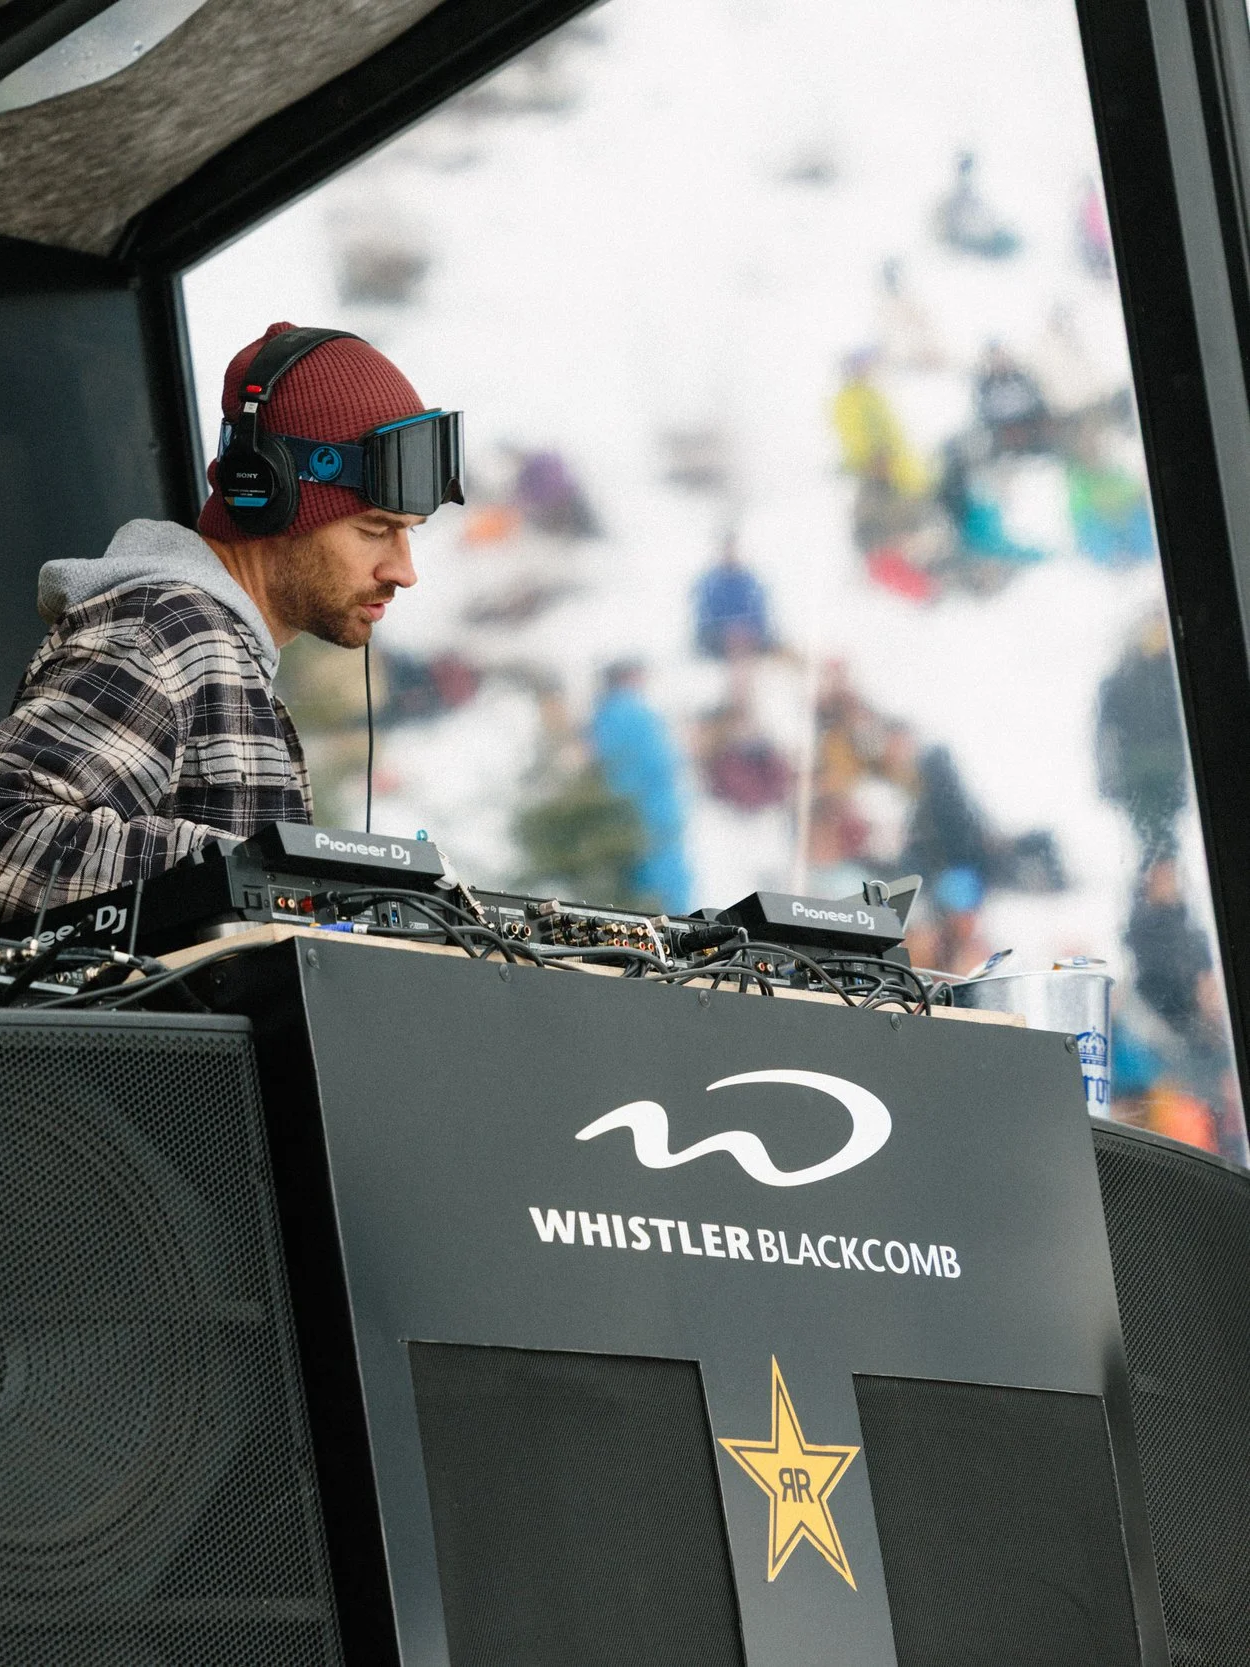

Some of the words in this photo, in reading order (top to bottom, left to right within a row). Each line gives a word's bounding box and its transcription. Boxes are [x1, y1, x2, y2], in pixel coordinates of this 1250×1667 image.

[315, 832, 387, 858] Pioneer
[792, 901, 854, 923] Pioneer
[528, 1206, 754, 1261] WHISTLER
[757, 1228, 962, 1280] BLACKCOMB
